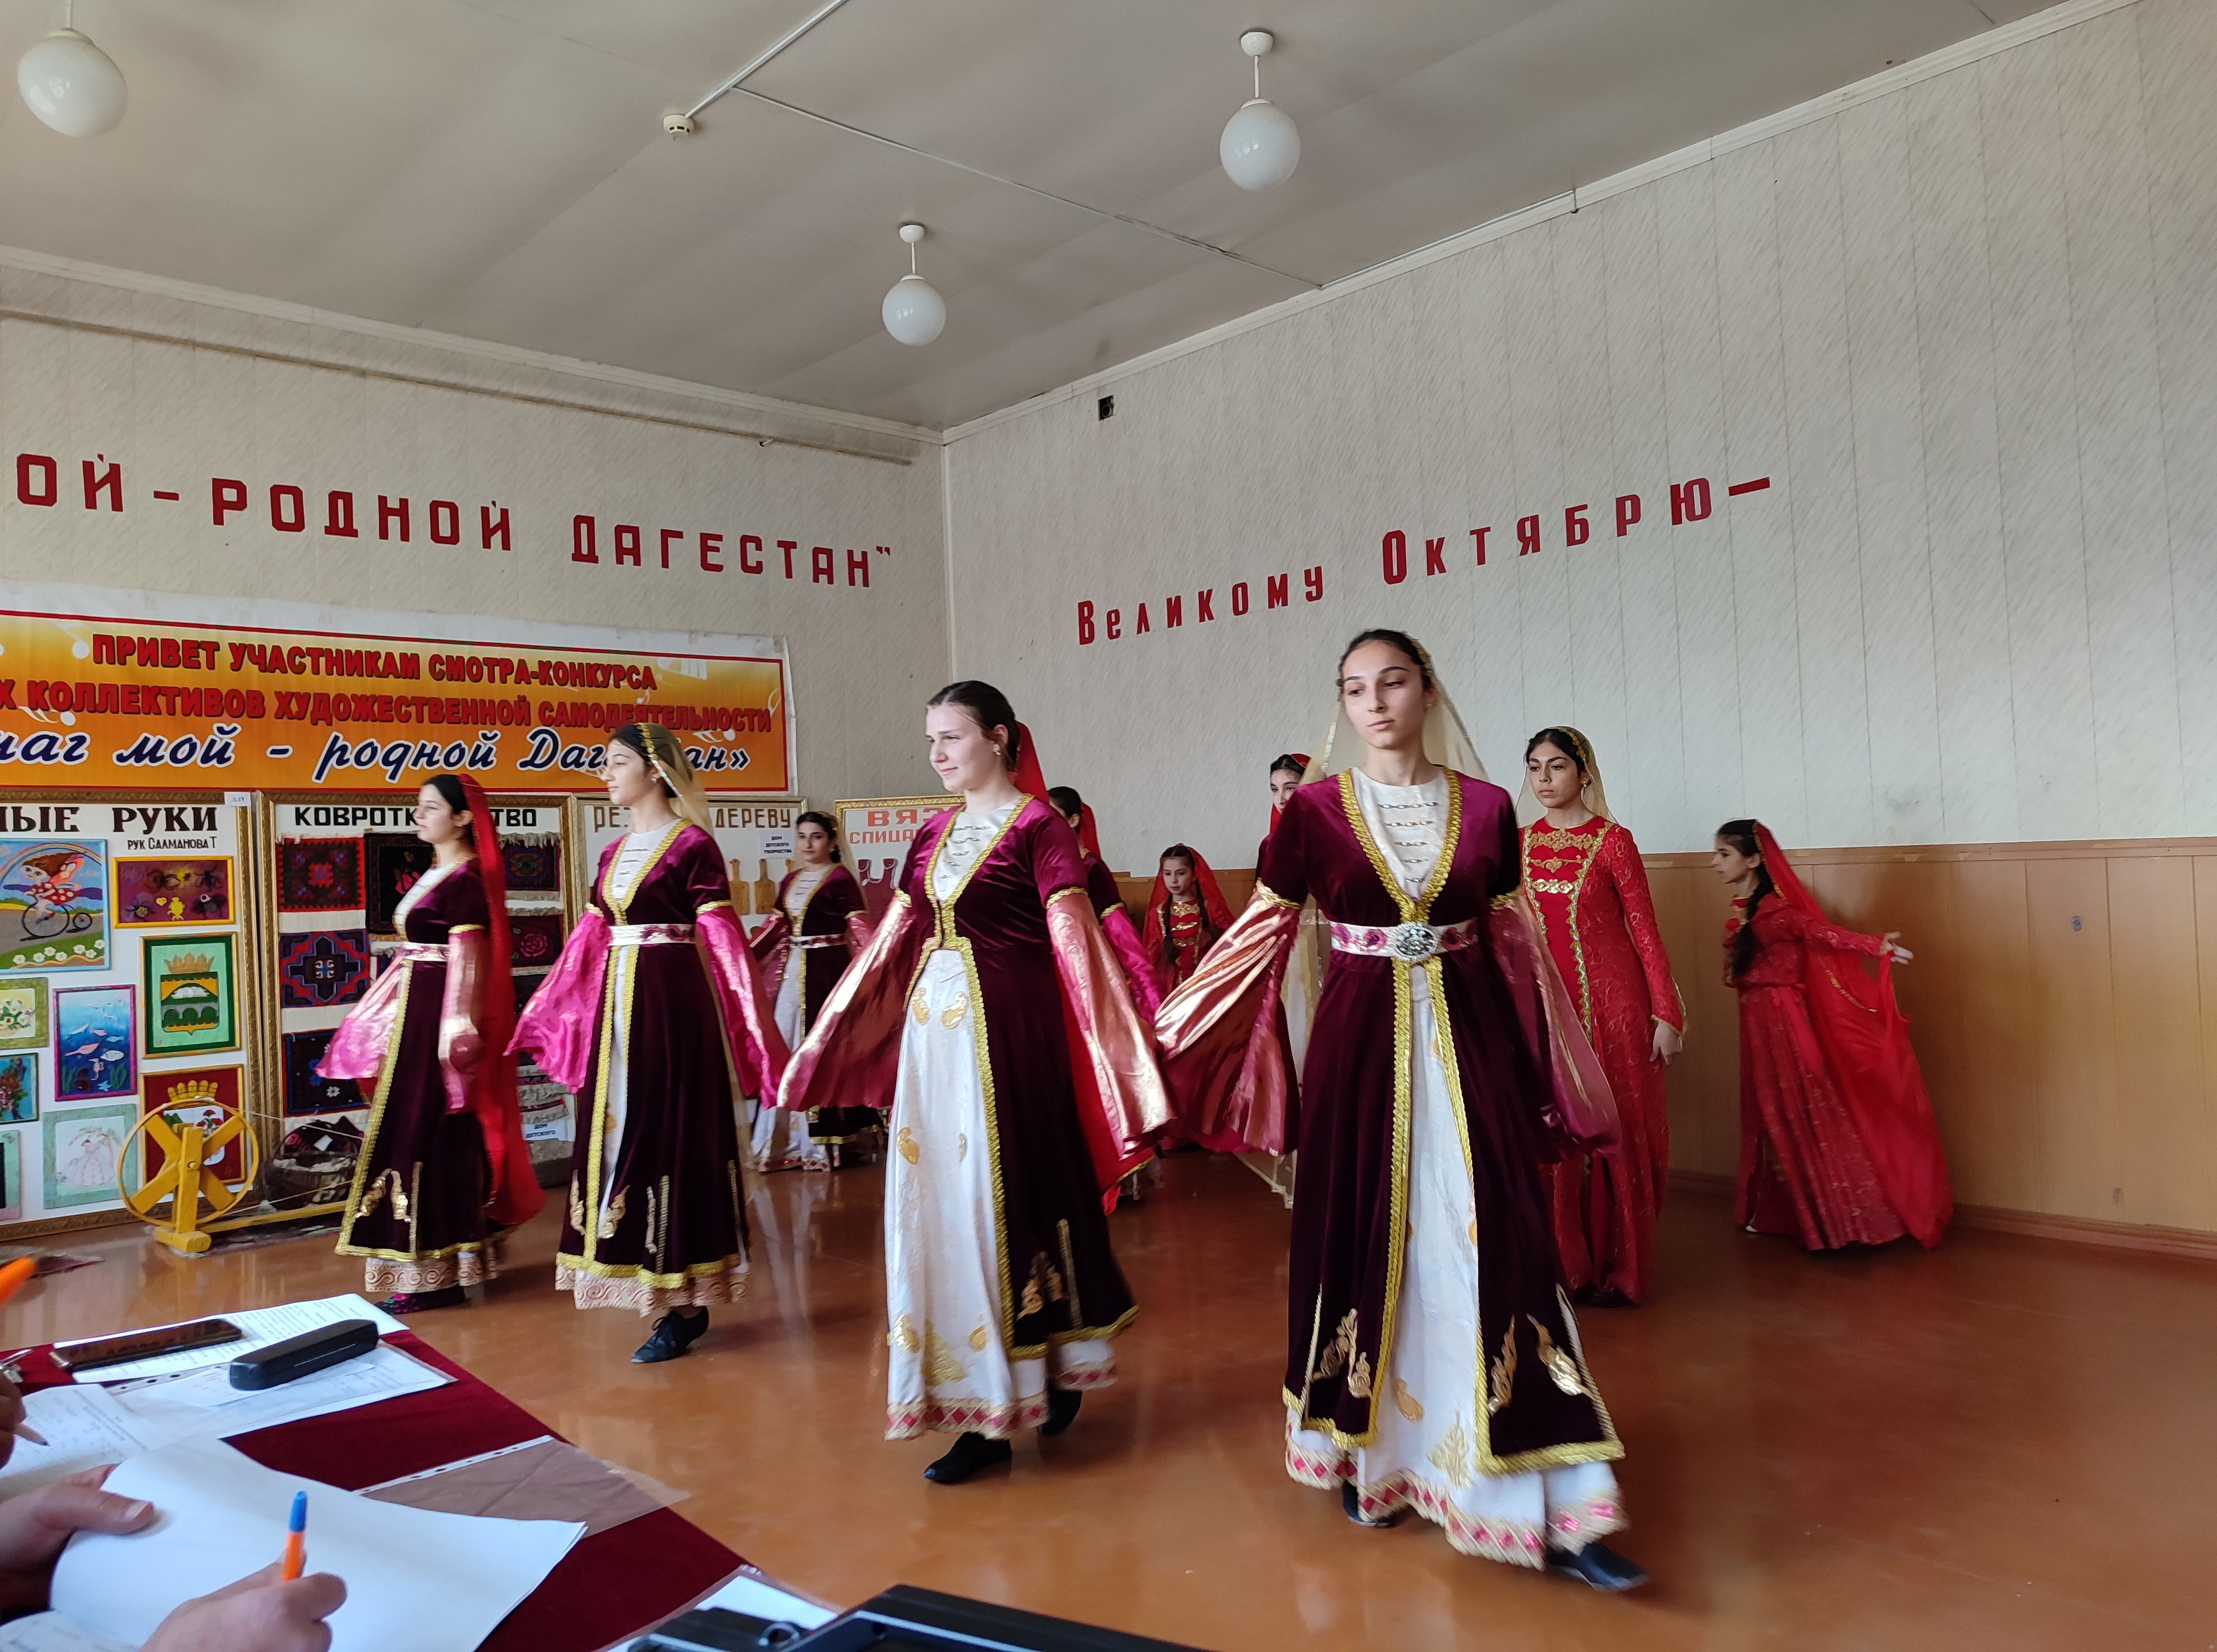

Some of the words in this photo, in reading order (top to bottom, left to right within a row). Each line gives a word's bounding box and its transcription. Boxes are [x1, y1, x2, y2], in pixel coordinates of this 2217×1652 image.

[16, 453, 124, 512] ОЙ
[212, 477, 511, 551] РОДНОЙ
[93, 633, 220, 671] ПРИВЕТ
[228, 642, 420, 679] УЧАСТНИКАМ
[428, 654, 657, 690] СМОТРА-КОНКУРСА
[27, 680, 267, 719] КОЛЛЕКТИВОВ
[274, 691, 532, 727] ХУДОЖЕСТВЕННОЙ
[538, 701, 772, 732] САМОДЕЯТЕЛЬНОСТИ
[115, 725, 235, 765] мой
[313, 732, 497, 782] родной
[518, 729, 749, 770] Даган»
[113, 807, 218, 835] РУКИ
[715, 808, 790, 828] ДЕРЕВУ
[849, 829, 918, 844] СПИЦА
